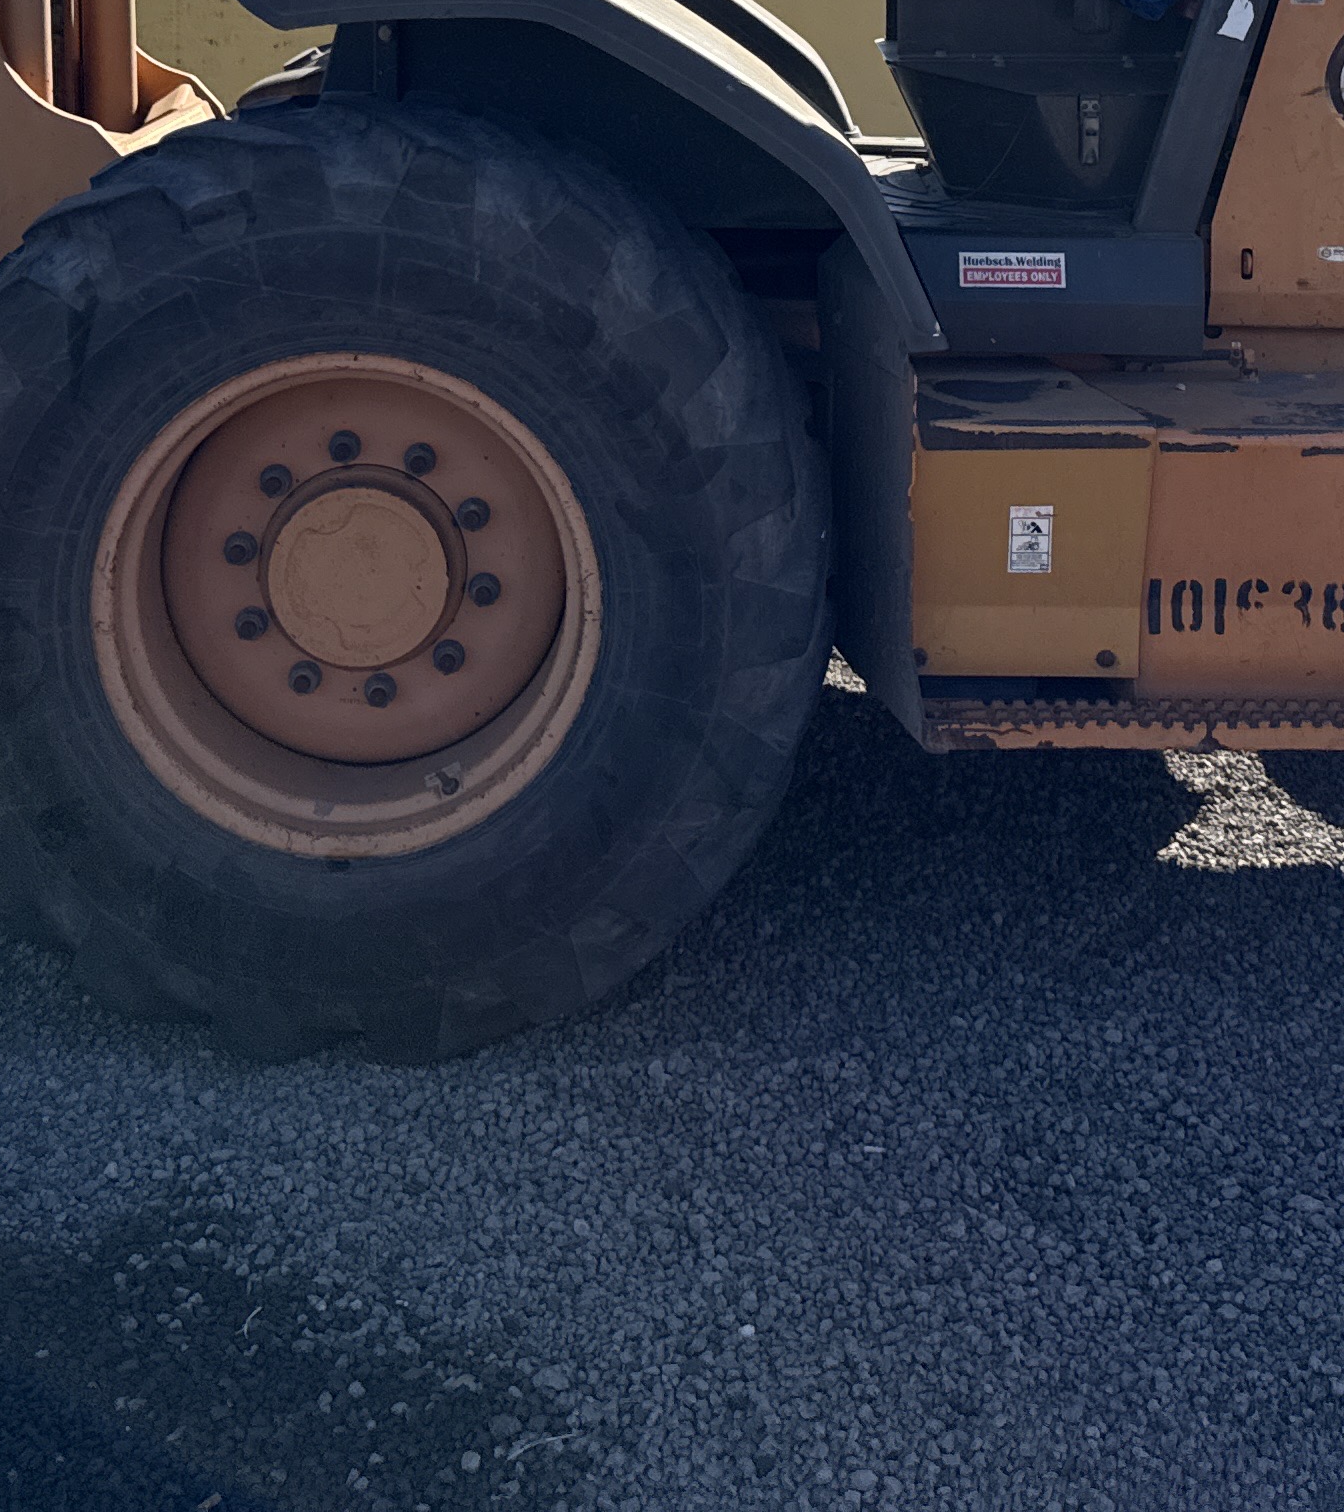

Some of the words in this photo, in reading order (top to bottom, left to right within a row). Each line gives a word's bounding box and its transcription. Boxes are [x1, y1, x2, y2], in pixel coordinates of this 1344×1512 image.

[963, 256, 1012, 266] Huebsch
[1016, 257, 1061, 268] Welding
[967, 272, 1027, 282] EMPLOYEES
[1030, 272, 1058, 282] ONLY
